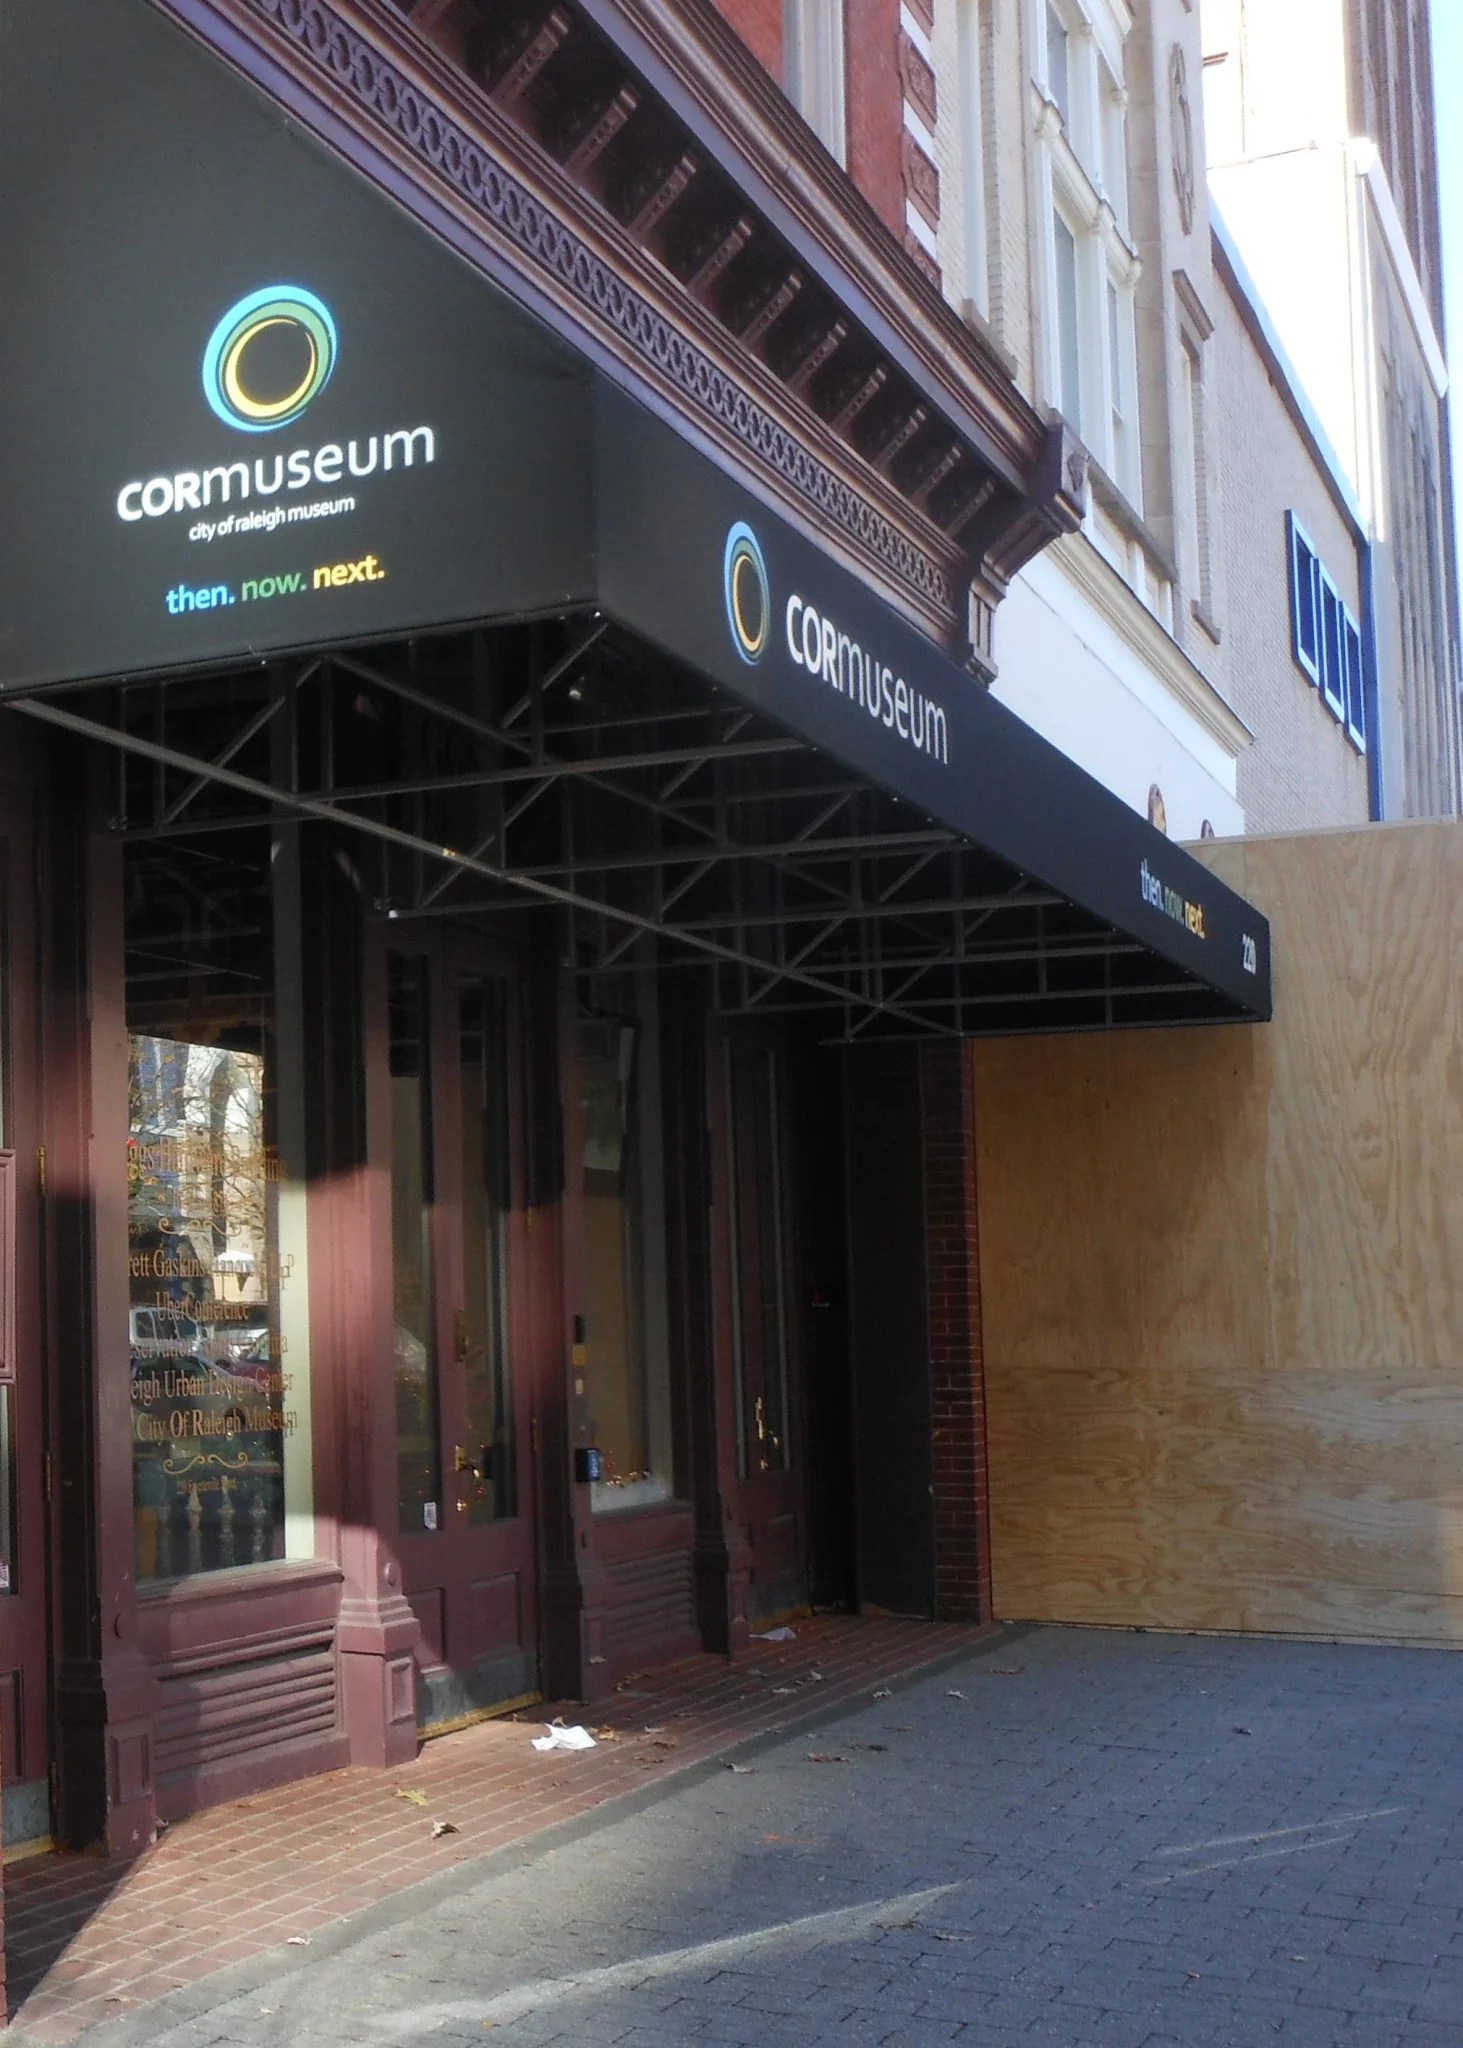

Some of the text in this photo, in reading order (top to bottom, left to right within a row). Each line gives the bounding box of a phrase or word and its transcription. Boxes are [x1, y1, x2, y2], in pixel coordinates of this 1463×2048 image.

[117, 425, 435, 522] CORmuseum
[189, 496, 355, 542] city of raleigh museum
[166, 555, 386, 615] then. now. next.
[786, 594, 949, 765] CORmuseum
[153, 1247, 206, 1278] Gaskins
[164, 1369, 205, 1398] Urban
[254, 1367, 294, 1394] Center
[136, 1406, 298, 1441] City Of Raleigh Museum
